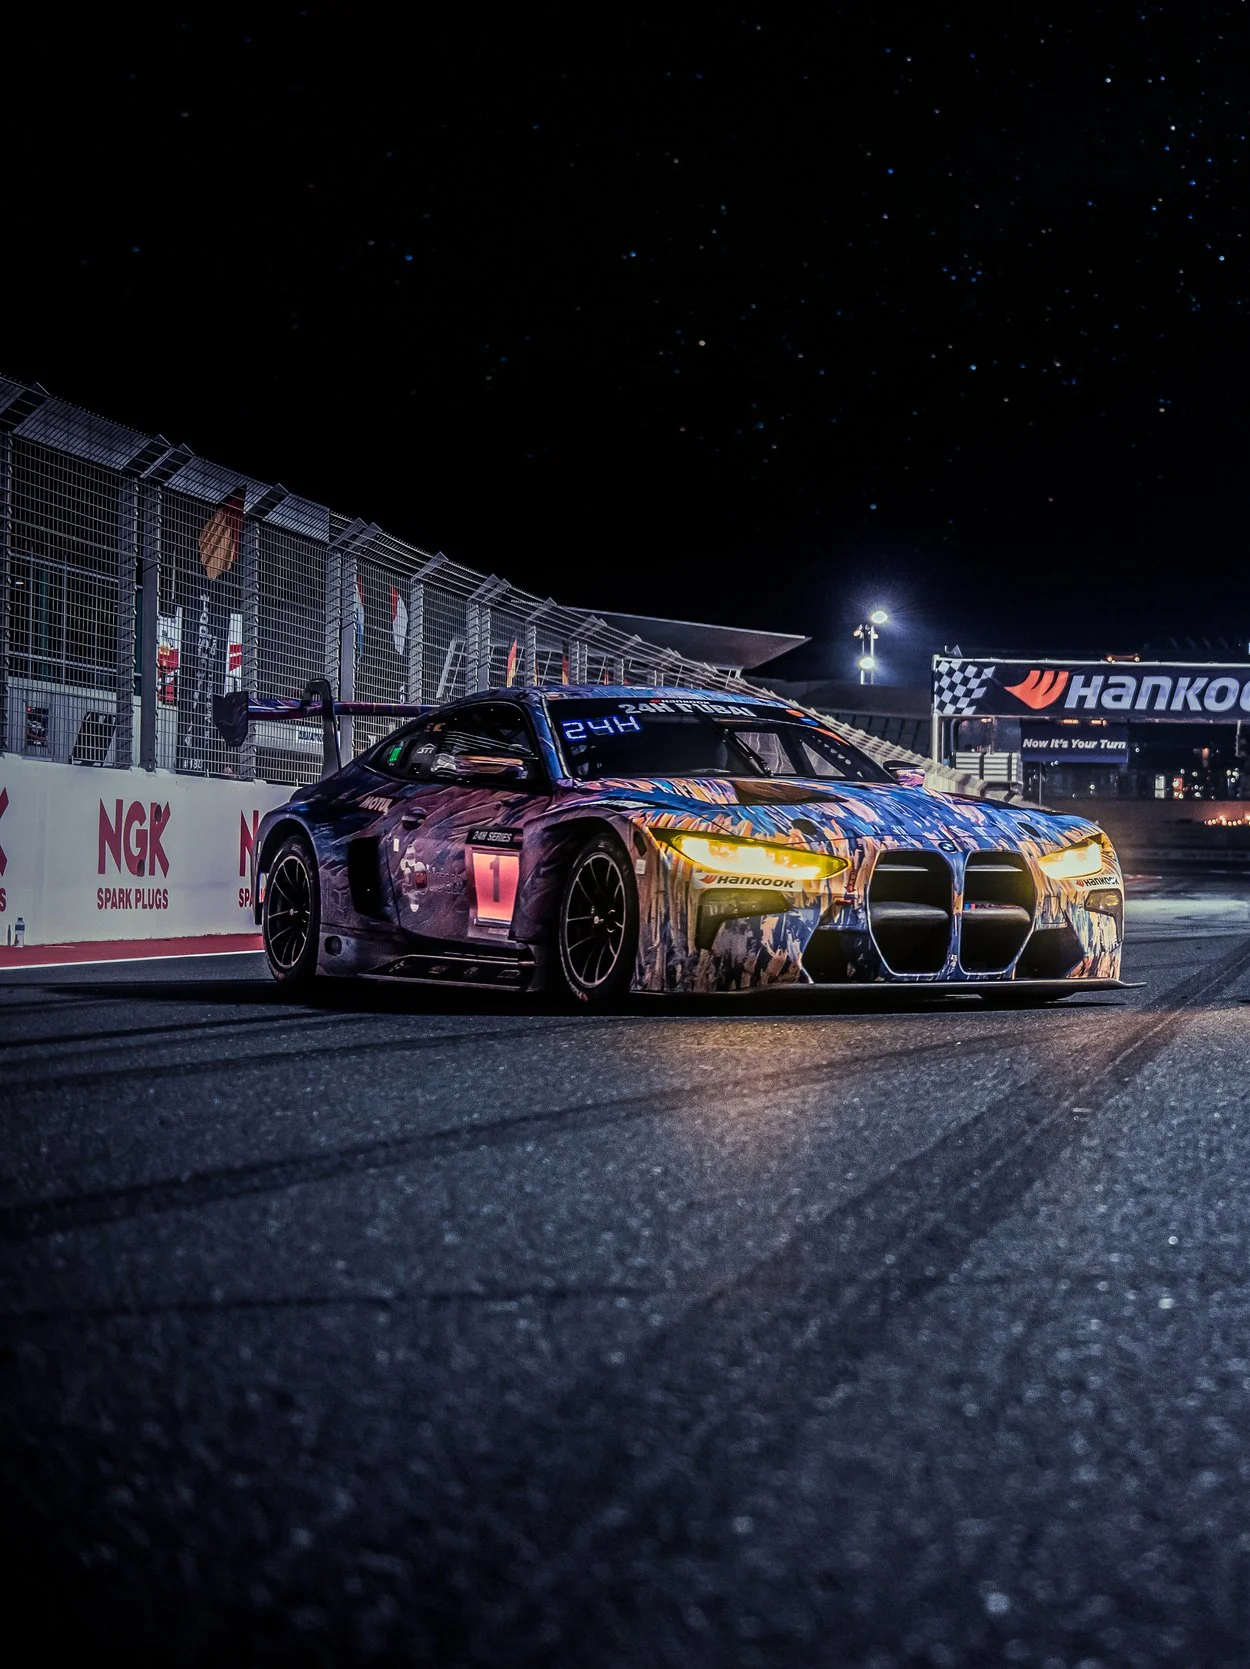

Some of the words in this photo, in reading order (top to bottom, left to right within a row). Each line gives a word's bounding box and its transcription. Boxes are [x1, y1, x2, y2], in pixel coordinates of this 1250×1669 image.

[618, 702, 675, 714] 24H
[674, 703, 757, 717] DUBAI
[563, 716, 640, 739] 24H
[1023, 738, 1048, 748] Now
[1050, 738, 1068, 748] It's
[1071, 738, 1098, 748] Your
[1100, 739, 1126, 749] Turn
[359, 796, 393, 815] MOTUL
[97, 798, 171, 879] NGK
[487, 831, 512, 842] SERIES
[489, 856, 501, 902] 1
[97, 887, 132, 909] SPARK
[135, 887, 169, 909] PLUGS
